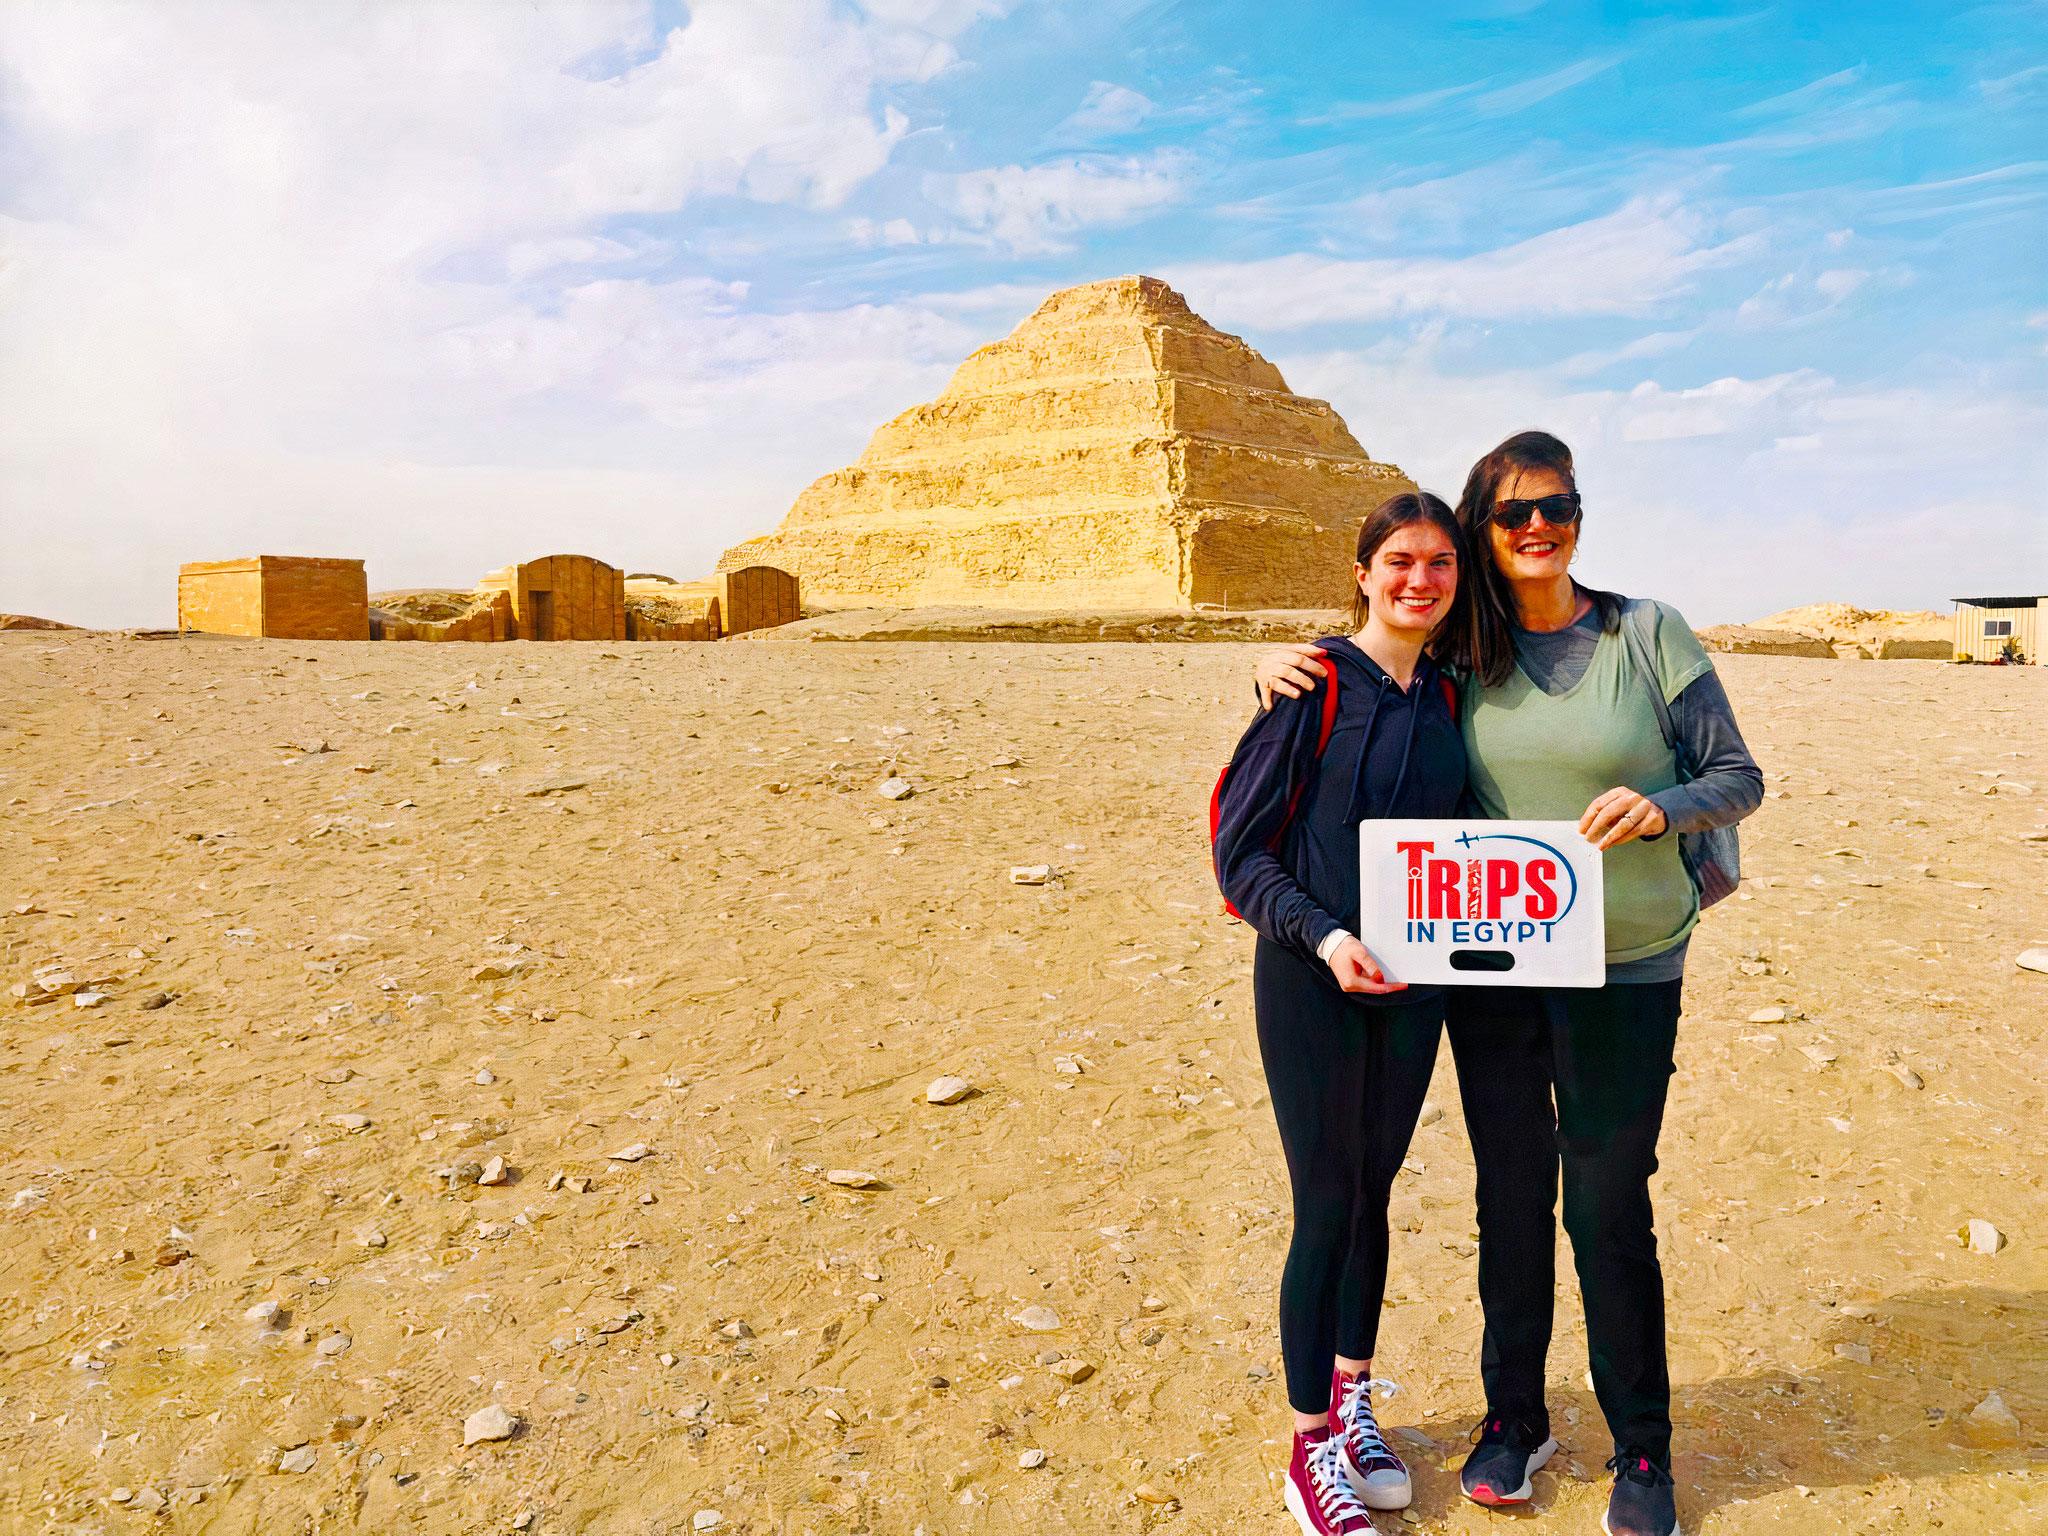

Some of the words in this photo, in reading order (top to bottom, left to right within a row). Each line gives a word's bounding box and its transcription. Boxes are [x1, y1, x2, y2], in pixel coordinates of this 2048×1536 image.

[1397, 841, 1557, 920] TRIPS
[1407, 921, 1435, 943] IN
[1452, 921, 1556, 943] EGYPT
